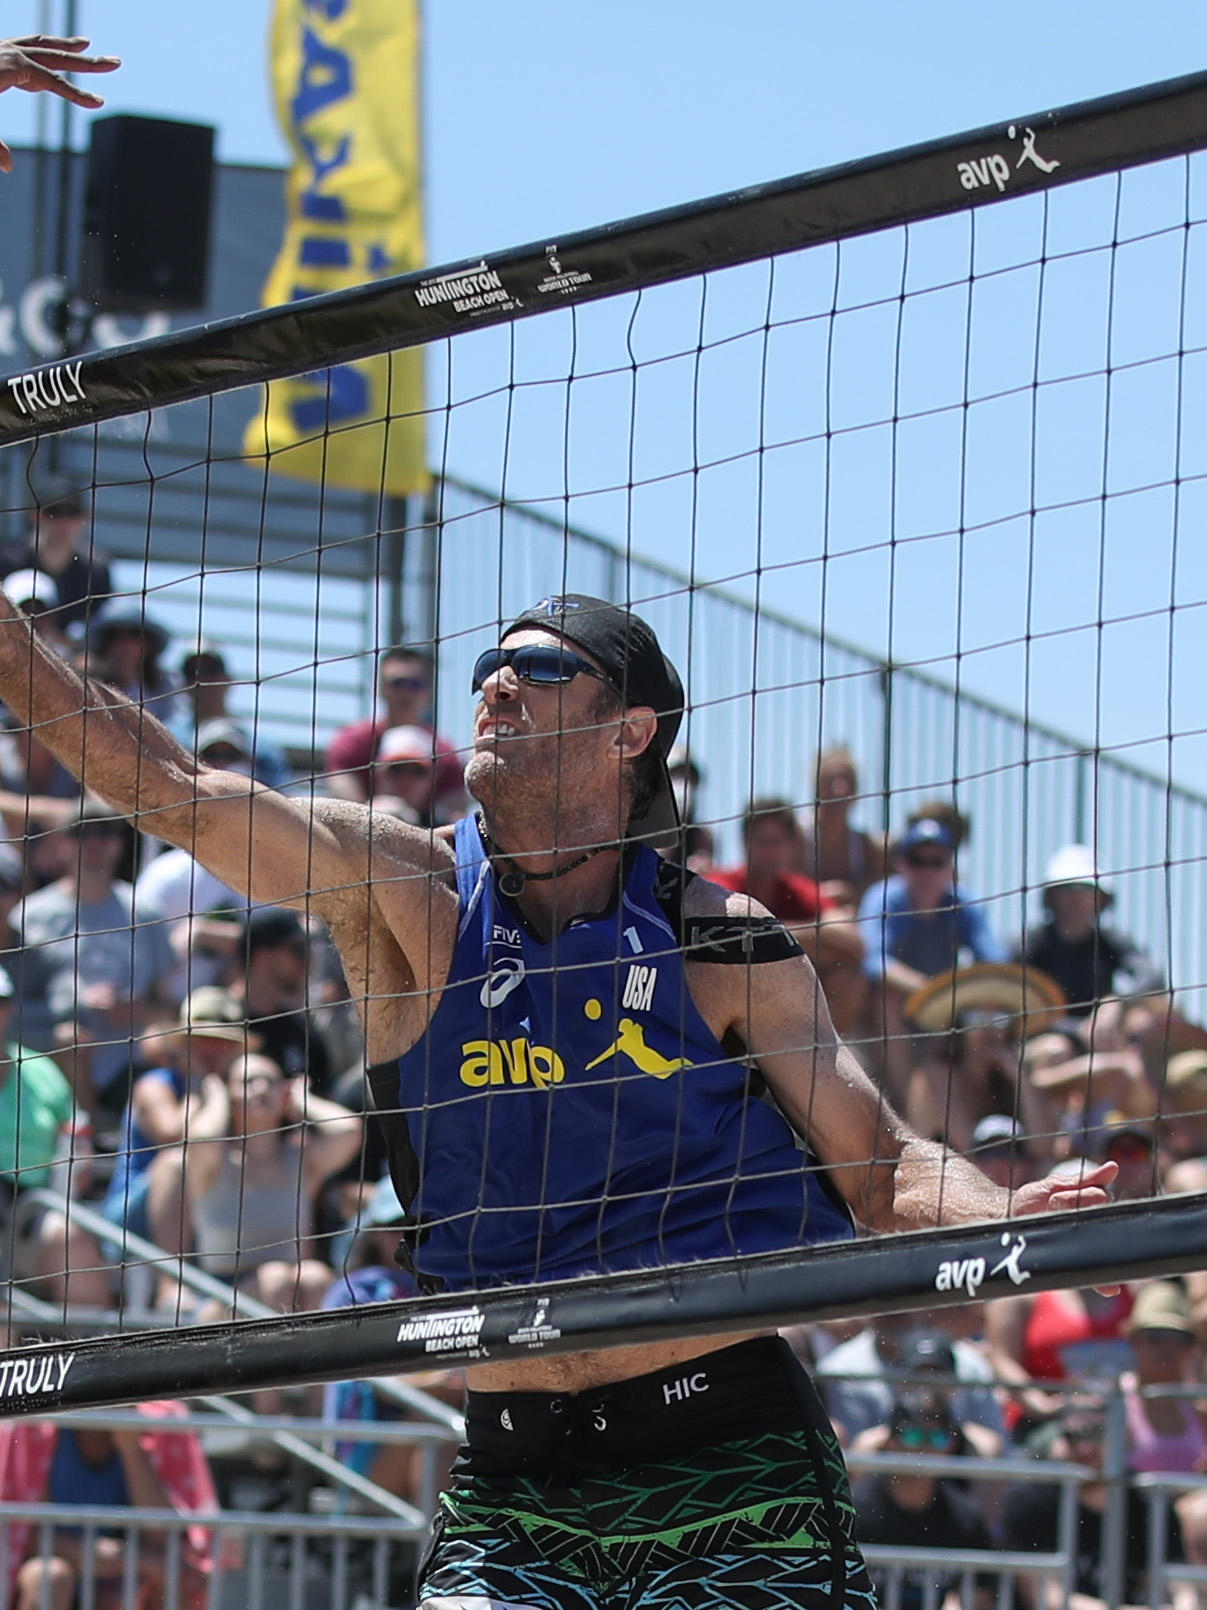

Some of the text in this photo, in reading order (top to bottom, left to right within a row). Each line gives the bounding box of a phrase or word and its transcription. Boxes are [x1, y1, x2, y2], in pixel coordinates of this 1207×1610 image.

[956, 153, 1010, 192] avp
[415, 268, 502, 307] HUNTINGTON
[453, 295, 484, 313] BEACH
[484, 289, 510, 305] OPEN
[7, 360, 87, 414] TRULY
[622, 925, 644, 954] 1
[621, 964, 658, 1012] USA
[459, 1037, 565, 1090] avp
[935, 1257, 986, 1298] avp
[397, 1314, 485, 1343] HUNTINGTON
[425, 1335, 480, 1353] BEACH OPEN
[662, 1372, 710, 1405] HIC
